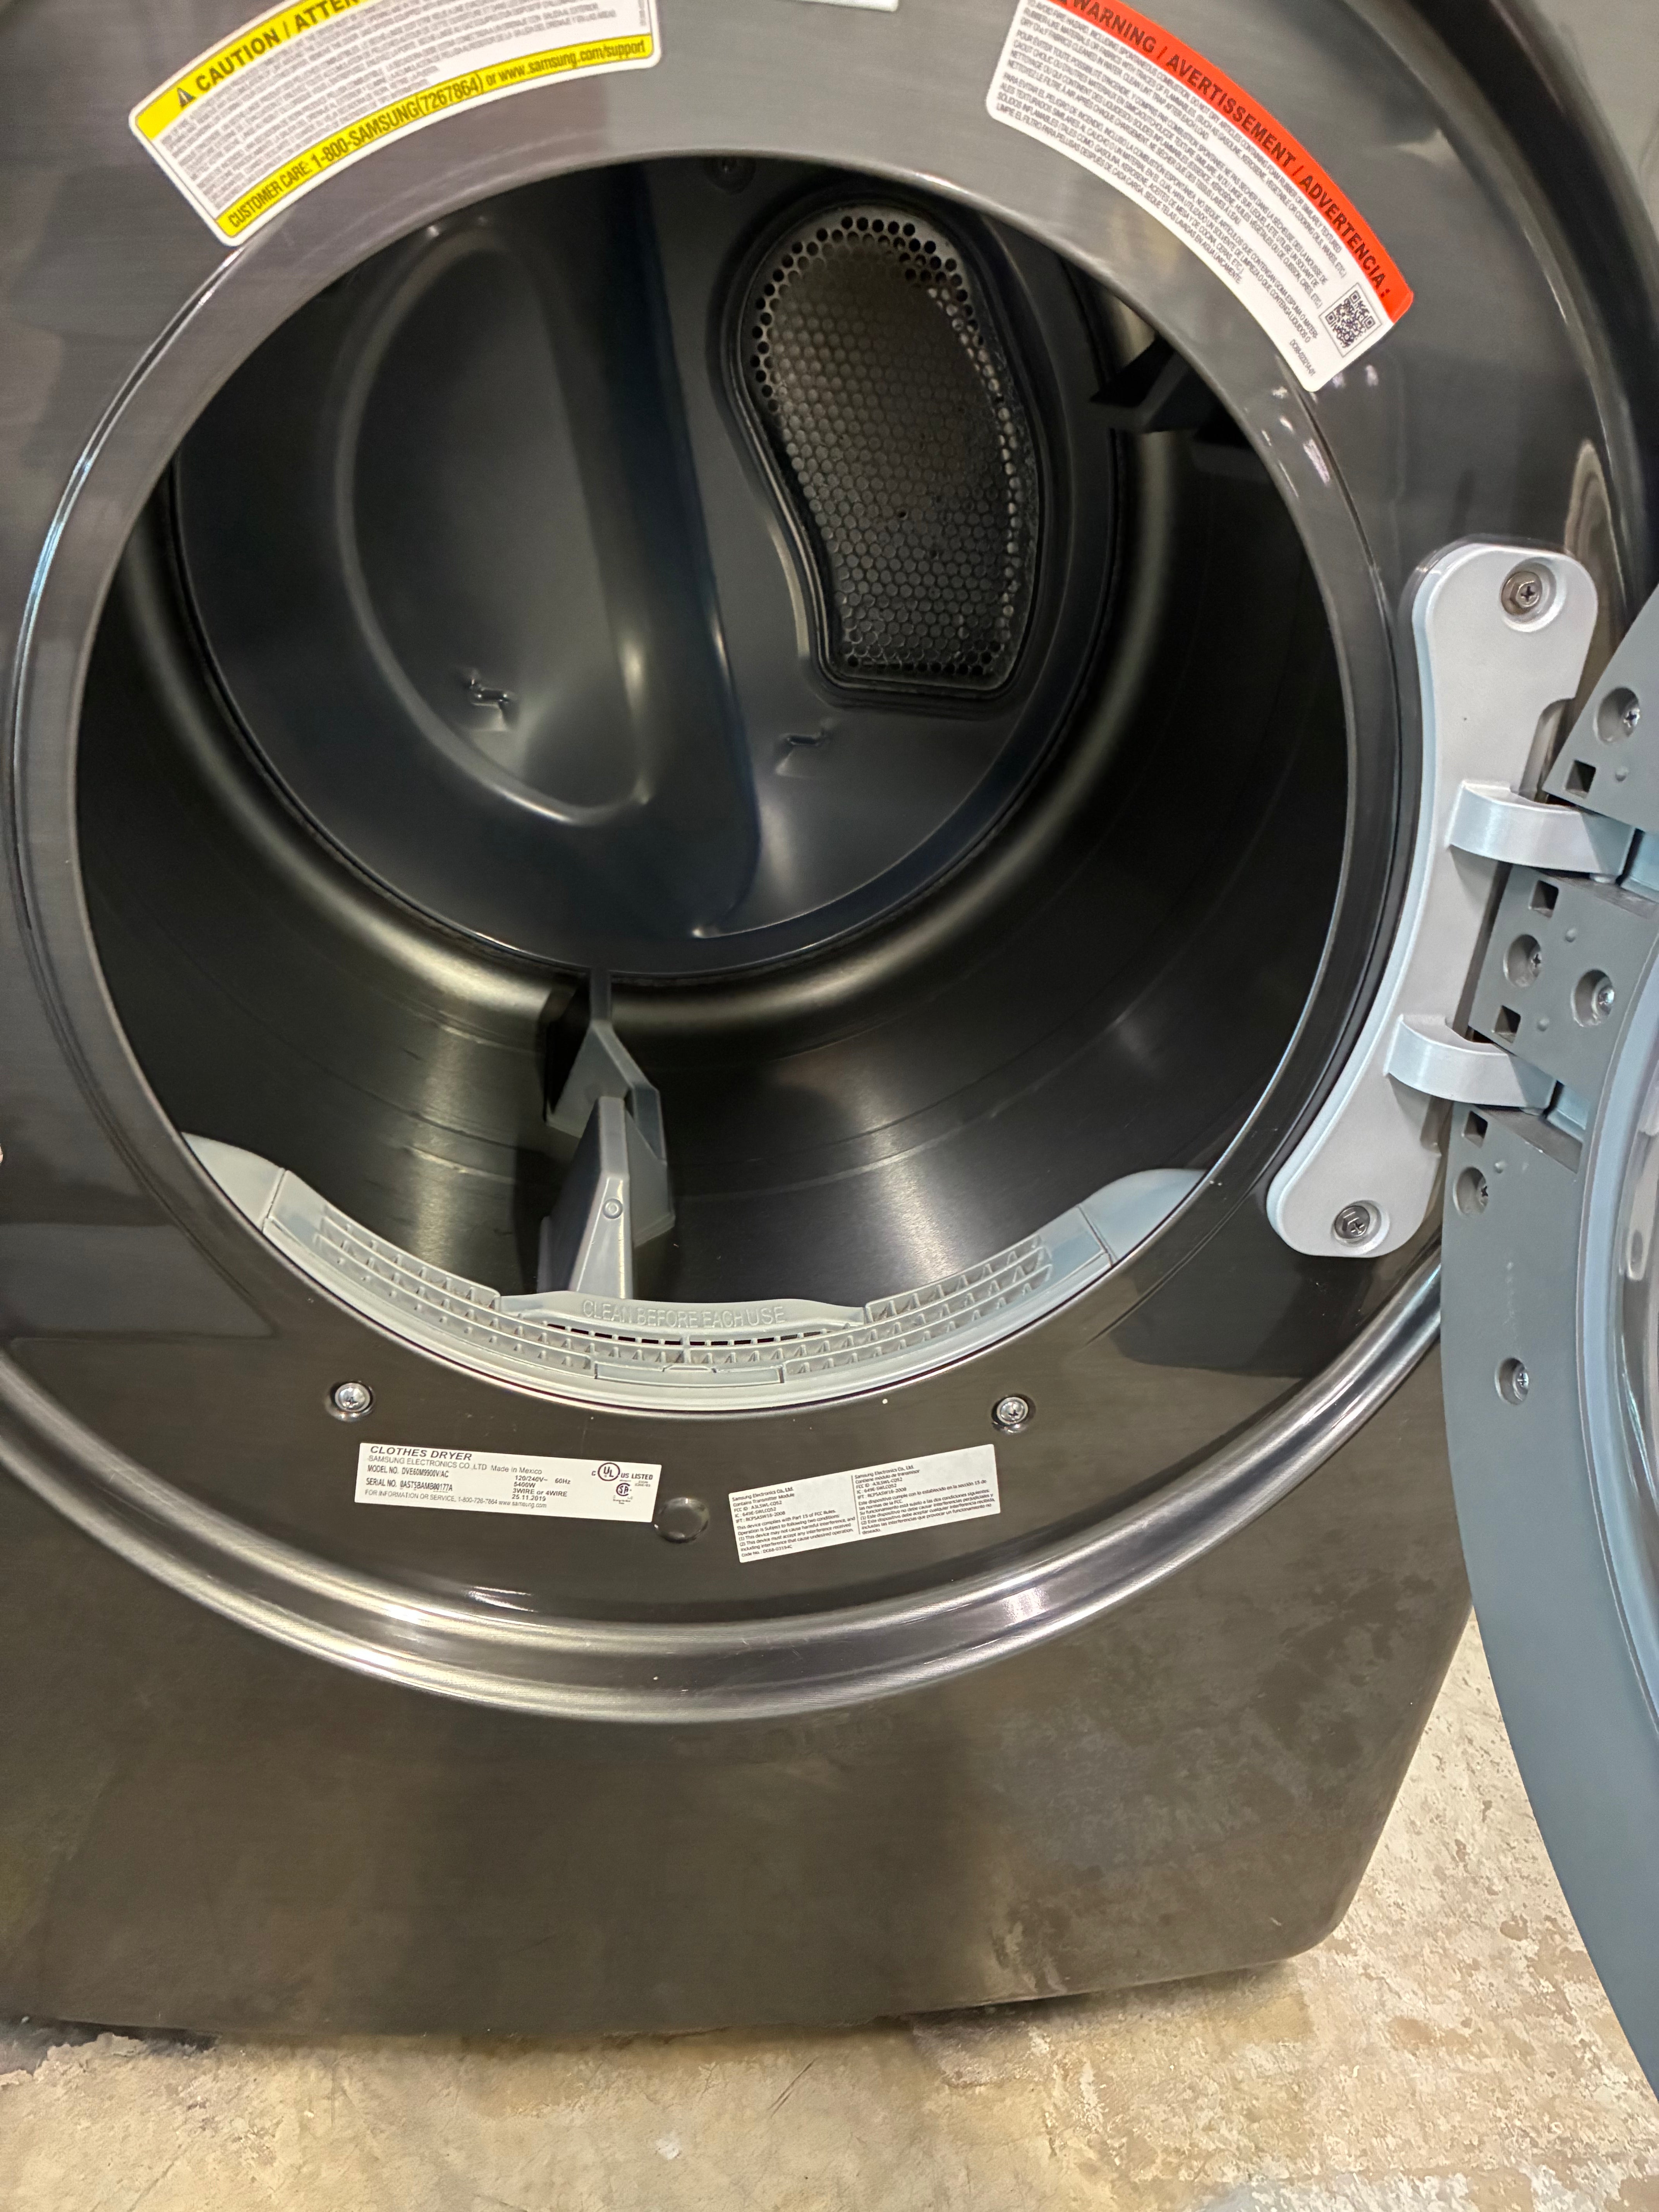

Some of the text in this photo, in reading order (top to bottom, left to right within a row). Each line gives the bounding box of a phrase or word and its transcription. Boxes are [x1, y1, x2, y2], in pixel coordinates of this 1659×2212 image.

[196, 27, 282, 92] CAUTION
[228, 40, 646, 228] CUSTOMER CARE: 1-800-SAMSUNG(7267864) or www.samsung.com/support
[1074, 0, 1155, 52] WARNING
[1166, 55, 1295, 167] AVERTISSEMENT
[1300, 176, 1385, 288] ADVERTENCIA
[1191, 219, 1200, 228] DE
[1211, 127, 1219, 136] AS
[1266, 180, 1290, 205] VEGETABLE
[1288, 204, 1297, 213] OR
[1295, 211, 1314, 234] COOKING
[1312, 232, 1323, 246] OILS,
[1322, 245, 1337, 264] WAXES,
[1334, 262, 1346, 277] ETC.)
[1267, 165, 1281, 180] FOAM
[1295, 196, 1304, 206] OR
[1302, 203, 1322, 227] SIMILARLY
[1321, 226, 1341, 252] TEXTURED
[1194, 234, 1203, 244] EN
[1255, 199, 1327, 284] DANS LA DES LA MOUSSE DE
[1234, 248, 1291, 317] DE LIMPIEZA QUE CONTENGA
[583, 1300, 787, 1328] CLEAN BEFORE EACH USE
[368, 1465, 387, 1473] MODEL
[369, 1455, 405, 1464] SAMSUNG
[407, 1458, 457, 1468] ELECTRONICS
[371, 1446, 472, 1460] CLOTHES DRYER
[366, 1478, 385, 1486] SERIAL
